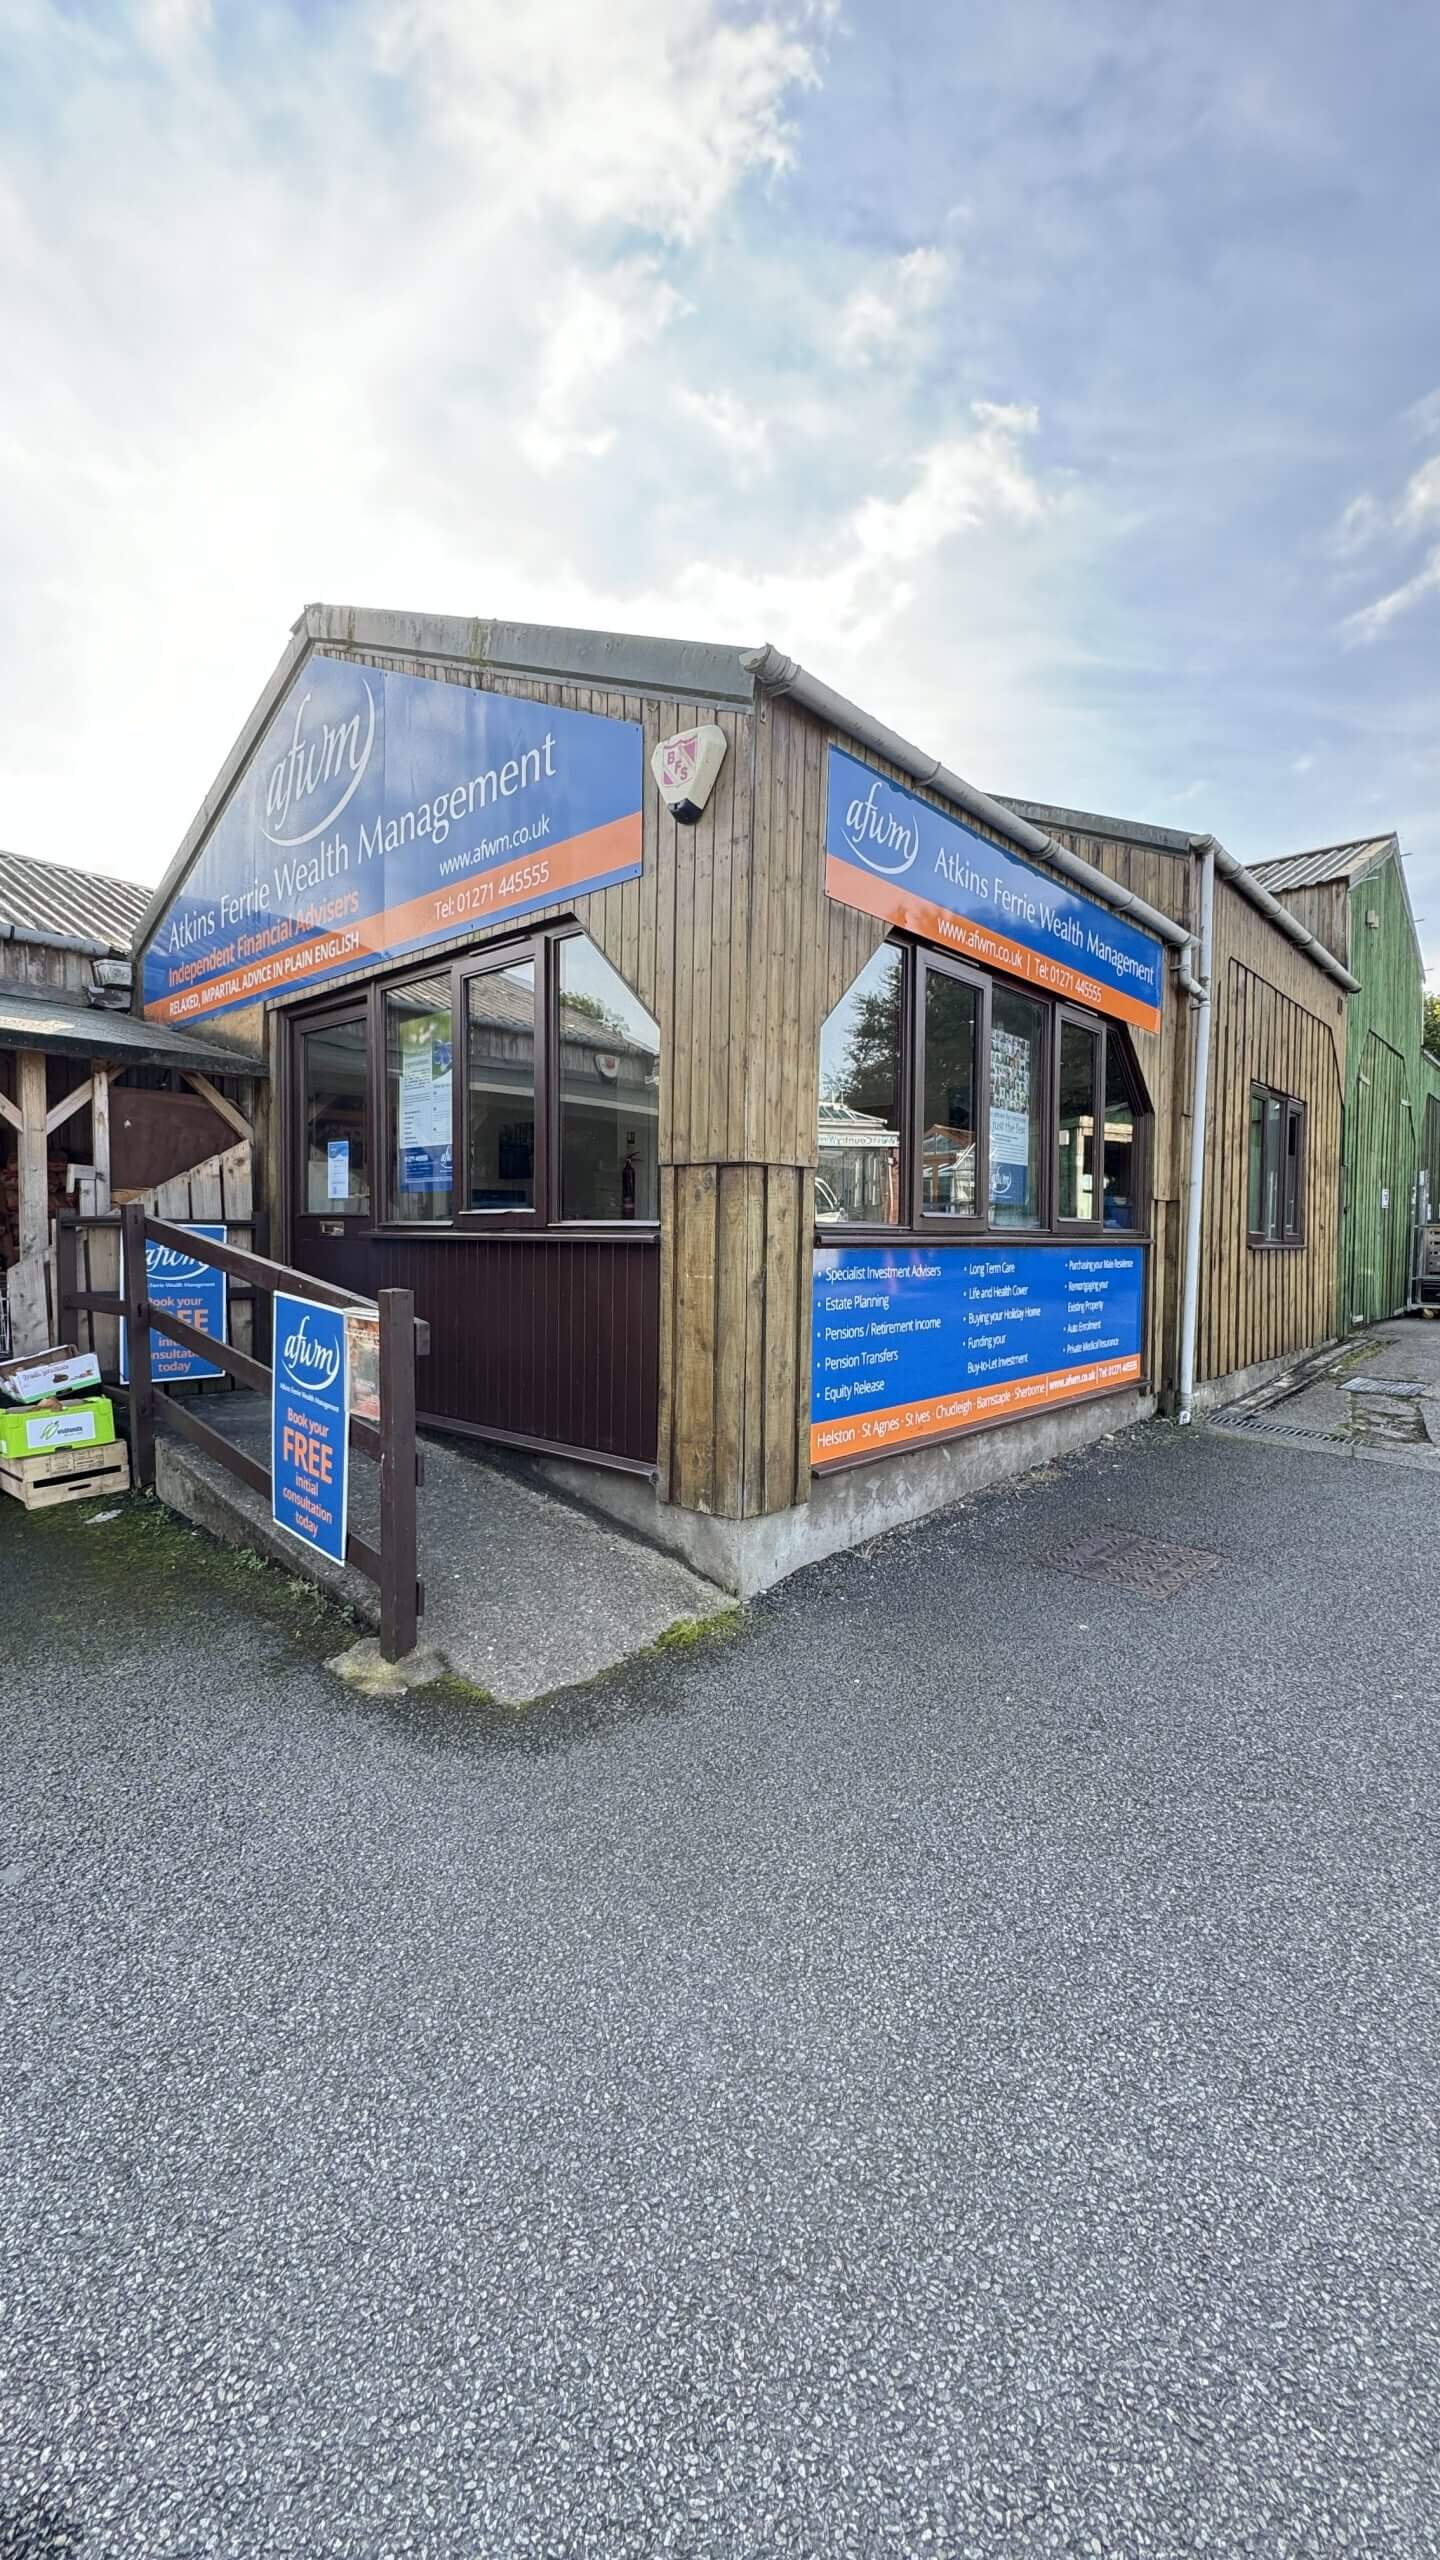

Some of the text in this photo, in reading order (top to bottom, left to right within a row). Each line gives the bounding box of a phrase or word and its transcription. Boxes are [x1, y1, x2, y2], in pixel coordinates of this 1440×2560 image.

[266, 693, 361, 831] afwm
[846, 782, 912, 860] afwm
[169, 732, 556, 953] Atkins Ferrie Wealth Management
[440, 814, 550, 877] www.afwm.co.uk
[434, 861, 550, 920] Tel: 01271 445555
[934, 848, 1155, 985] Atkins Ferrie Wealth Management
[168, 890, 359, 988] Independent Financial Advisers
[169, 930, 360, 1017] RELAXED, IMPARTIAL ADVICE IN PLAIN ENGLISH
[937, 917, 1101, 1002] www.afwm.co.uk Tel: 01271 445555
[825, 1264, 941, 1284] Specialist Investment Advisers
[969, 1261, 1015, 1277] Long Term Care
[177, 1297, 202, 1309] your
[825, 1295, 890, 1311] Estate Planning
[969, 1285, 1029, 1300] Life and Health Cover
[825, 1326, 864, 1341] Pensions
[870, 1319, 914, 1335] Retirement
[914, 1317, 941, 1330] Income
[968, 1307, 1041, 1327] Buying your Holiday Home
[284, 1316, 334, 1376] afwm
[968, 1335, 1007, 1350] Funding your
[158, 1360, 192, 1374] today
[825, 1348, 899, 1371] Pension Transfers
[967, 1353, 1029, 1376] Buy-to-Let Investment
[825, 1379, 885, 1402] Equity Release
[287, 1407, 329, 1438] Book your
[817, 1428, 856, 1449] Helston
[861, 1422, 872, 1438] St
[872, 1417, 900, 1438] Agnes
[905, 1412, 914, 1427] St
[914, 1410, 931, 1425] Ives
[935, 1399, 972, 1420] Chudleigh
[976, 1391, 1011, 1410] Barnstaple
[283, 1425, 333, 1484] FREE
[295, 1472, 319, 1497] initial
[283, 1487, 333, 1525] consultation
[295, 1510, 318, 1538] today
